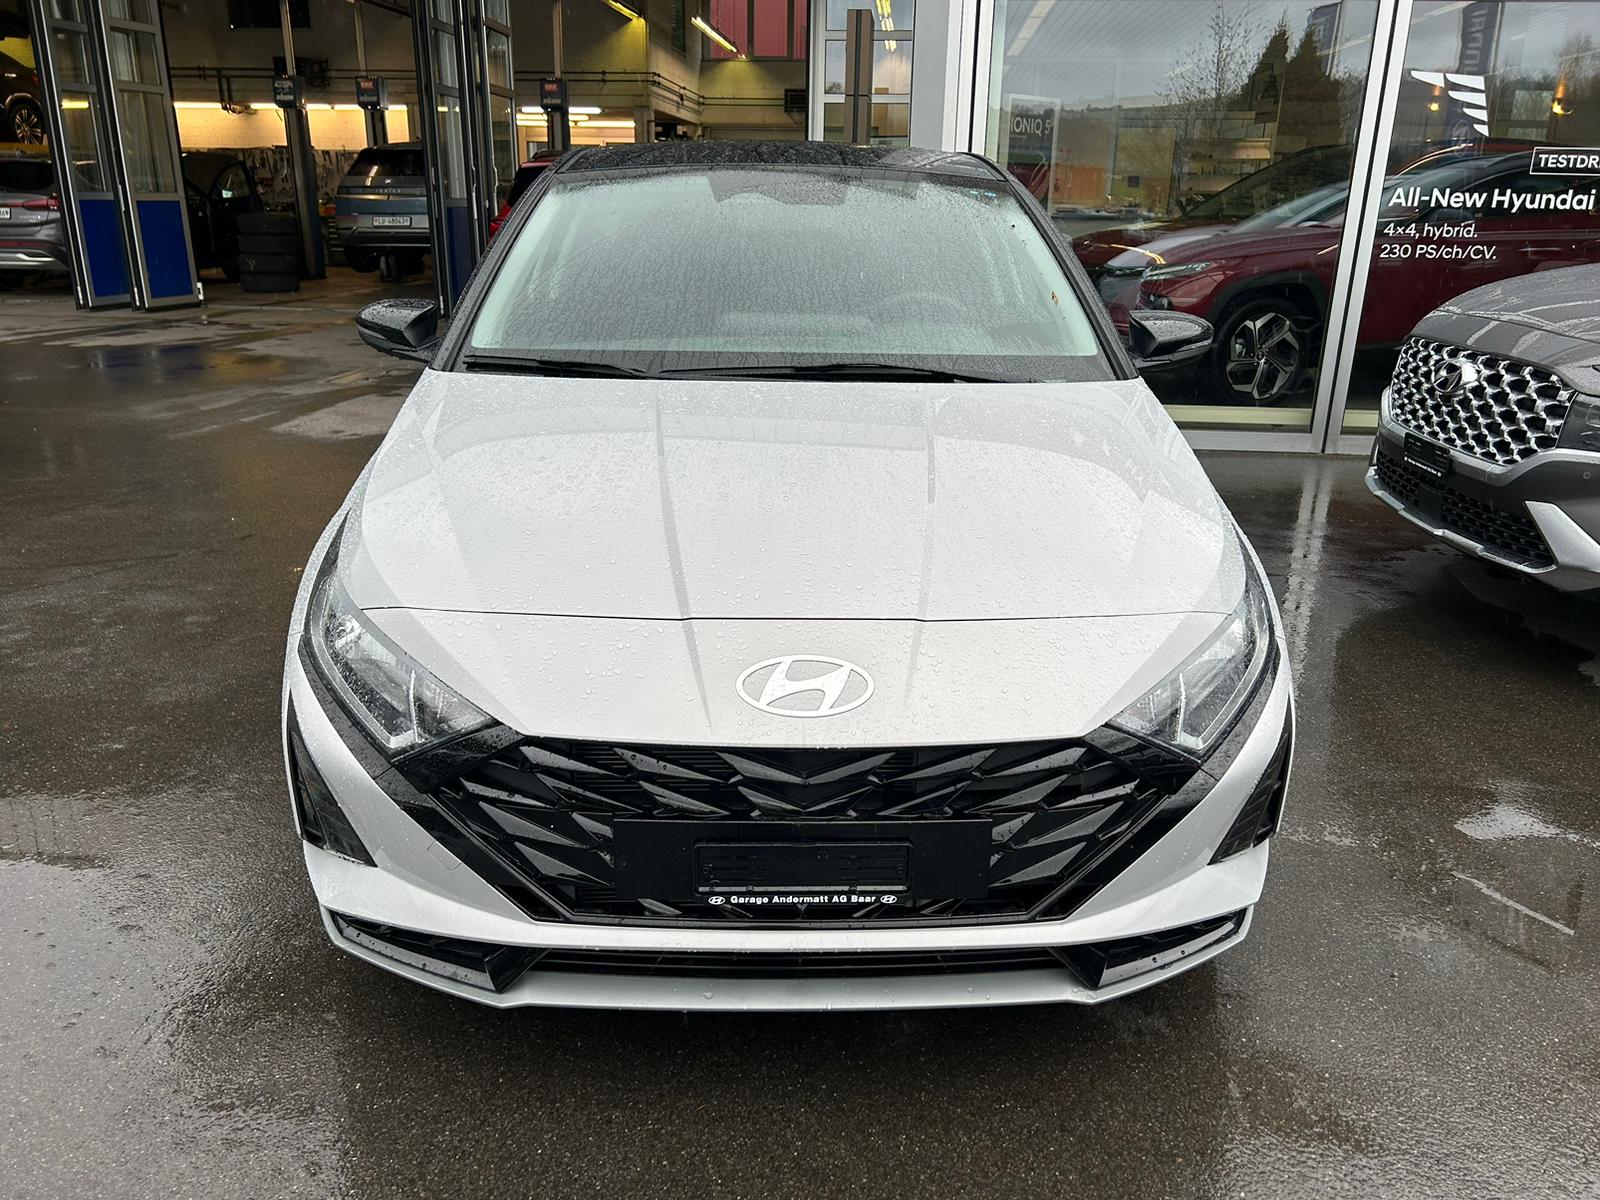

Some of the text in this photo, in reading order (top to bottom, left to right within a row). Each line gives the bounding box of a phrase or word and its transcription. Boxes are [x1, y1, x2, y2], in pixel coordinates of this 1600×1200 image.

[1010, 116, 1042, 137] IONIQ
[1539, 154, 1600, 169] TESTDR
[1388, 187, 1597, 213] All-New Hyundai
[1422, 223, 1479, 241] hybrid.
[1379, 244, 1497, 260] 230 PS/ch/CV.
[730, 895, 876, 905] Garage Andermatt AG Baar
